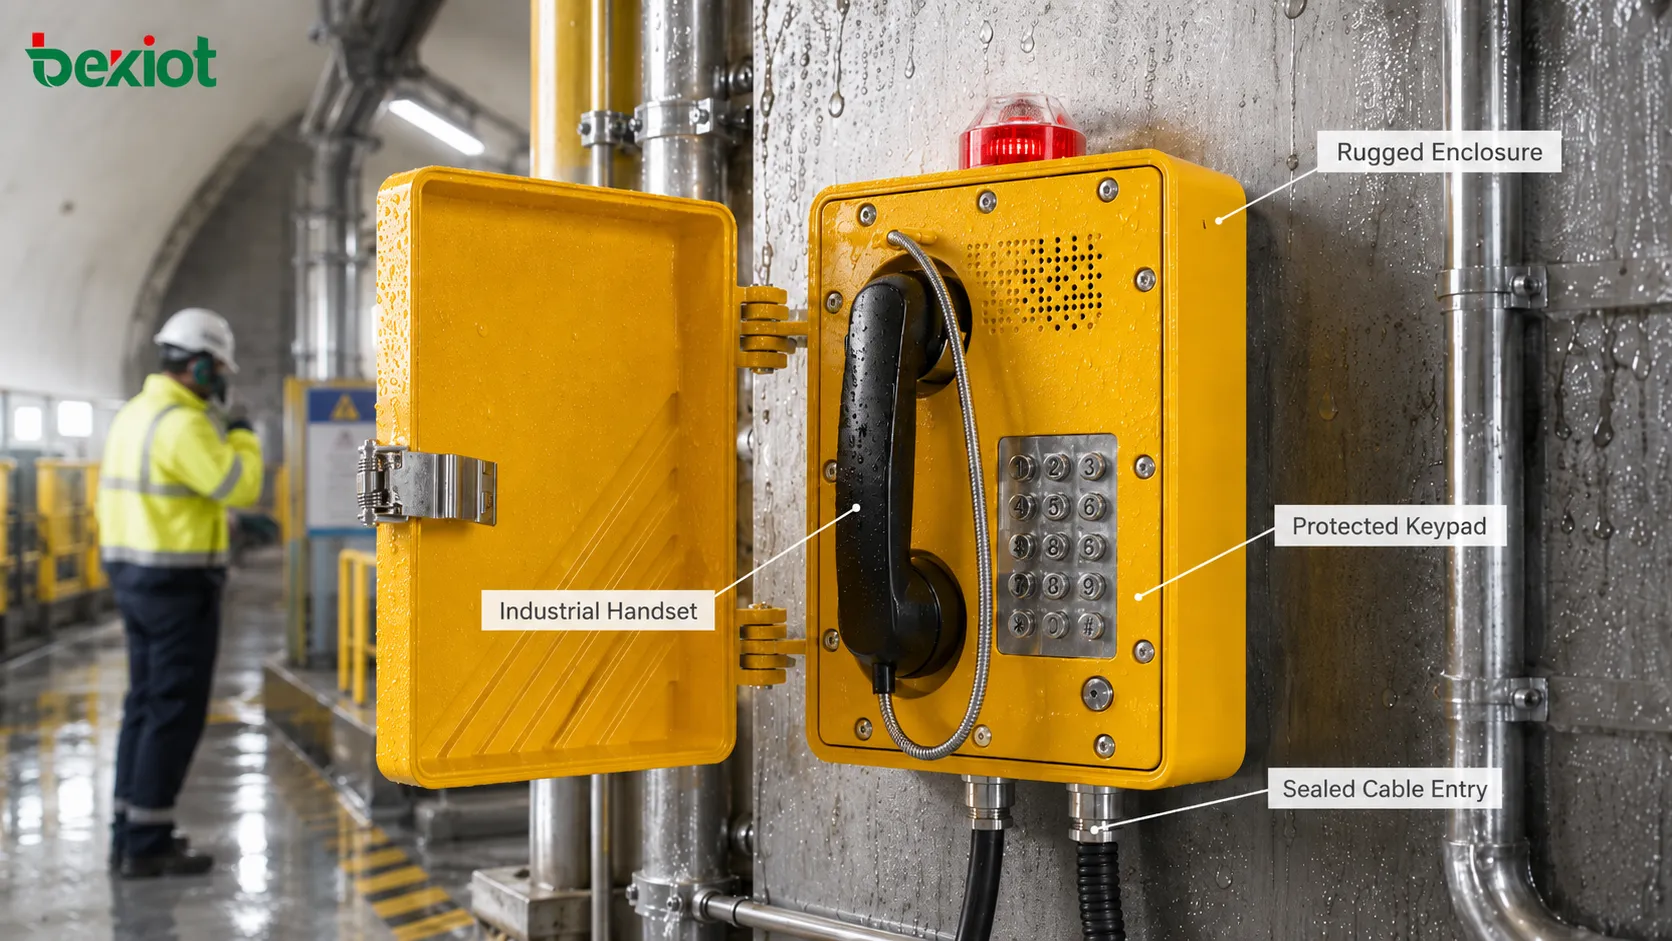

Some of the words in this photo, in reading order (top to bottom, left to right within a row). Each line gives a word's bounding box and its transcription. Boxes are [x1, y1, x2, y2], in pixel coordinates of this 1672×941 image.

[1048, 458, 1060, 477] 2
[1084, 458, 1095, 475] 3
[1048, 497, 1059, 516] 5
[1083, 497, 1095, 516] 6
[1047, 577, 1059, 595] 8
[1083, 577, 1094, 595] 9
